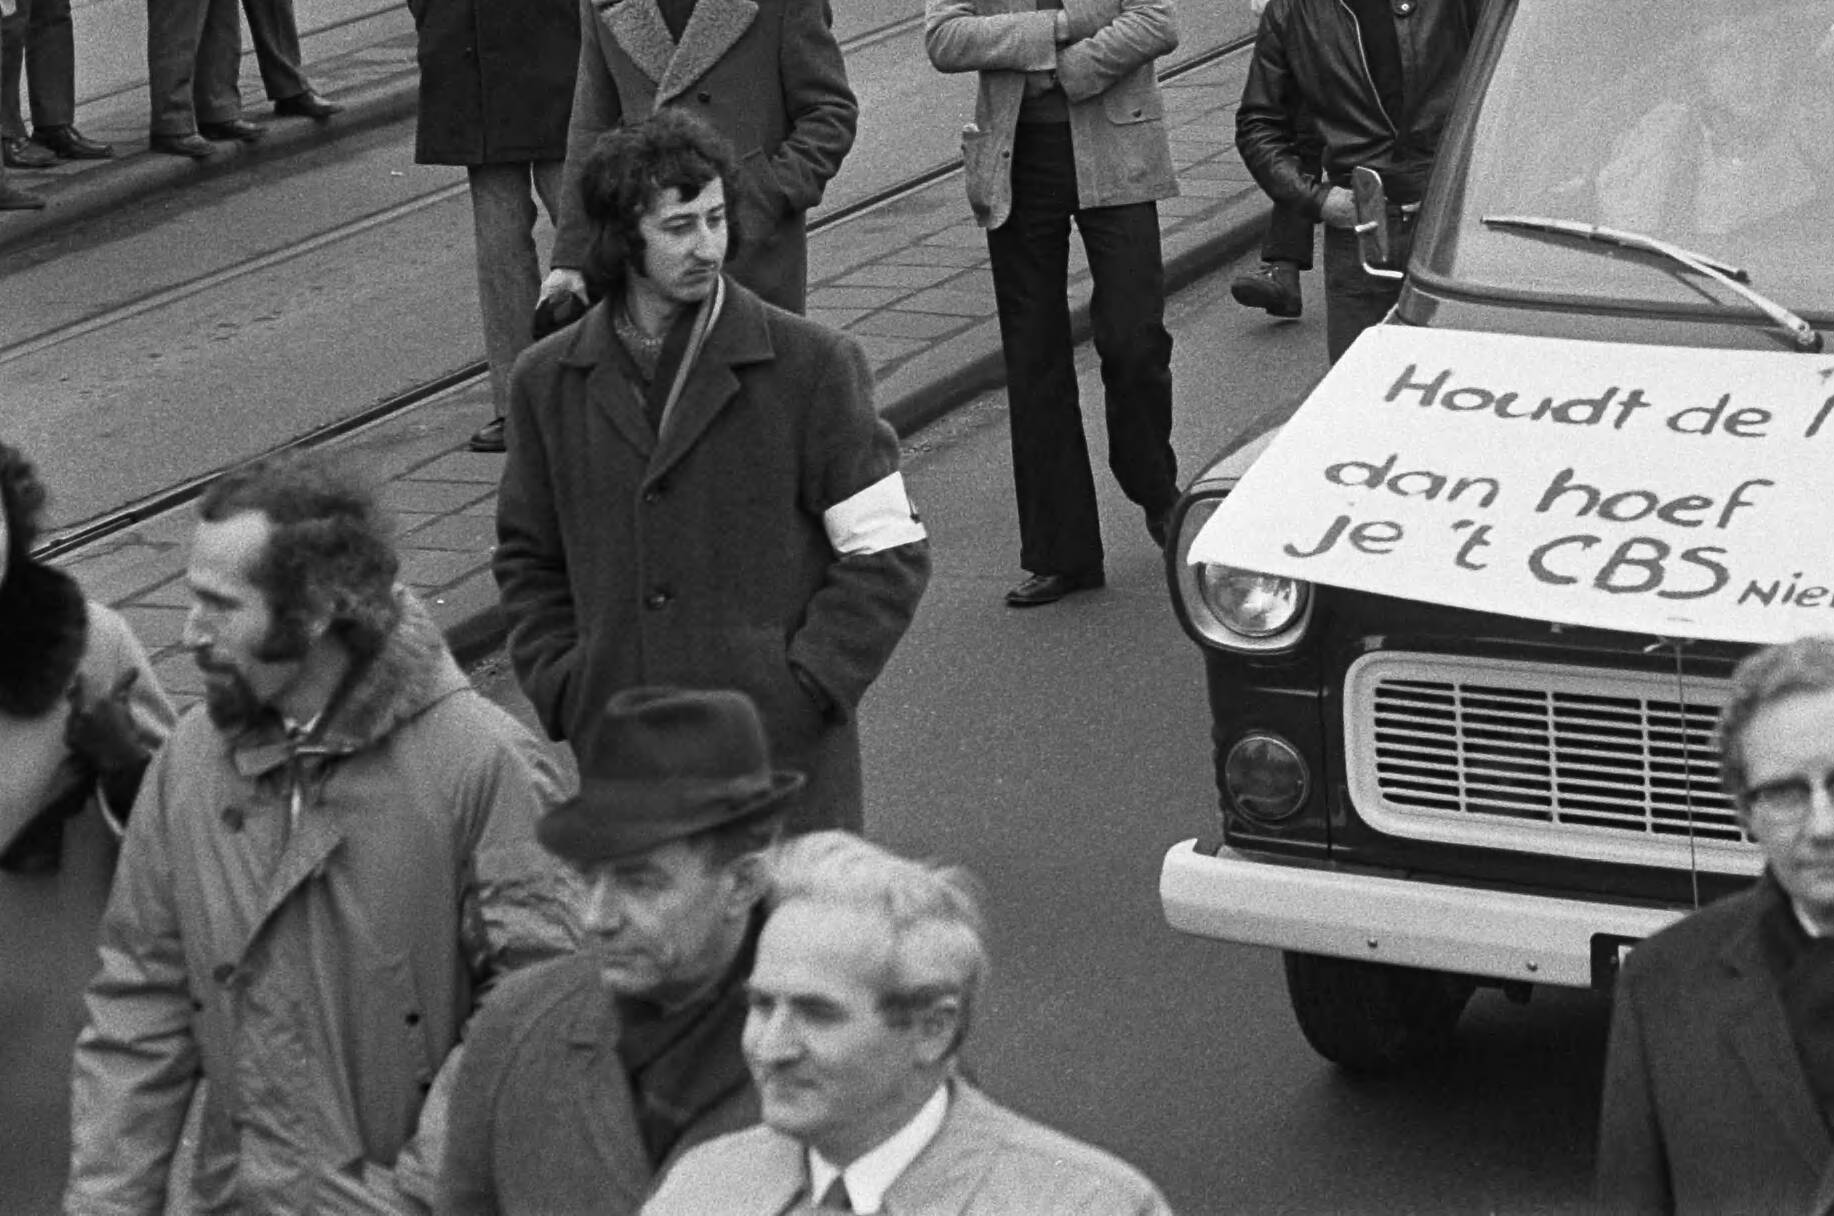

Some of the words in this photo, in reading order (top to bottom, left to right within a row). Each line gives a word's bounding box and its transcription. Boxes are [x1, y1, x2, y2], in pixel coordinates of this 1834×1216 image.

[1384, 363, 1650, 430] Houdt
[1666, 393, 1773, 438] de
[1323, 453, 1500, 509] dan
[1534, 467, 1776, 530] hoef
[1527, 533, 1730, 600] CBS
